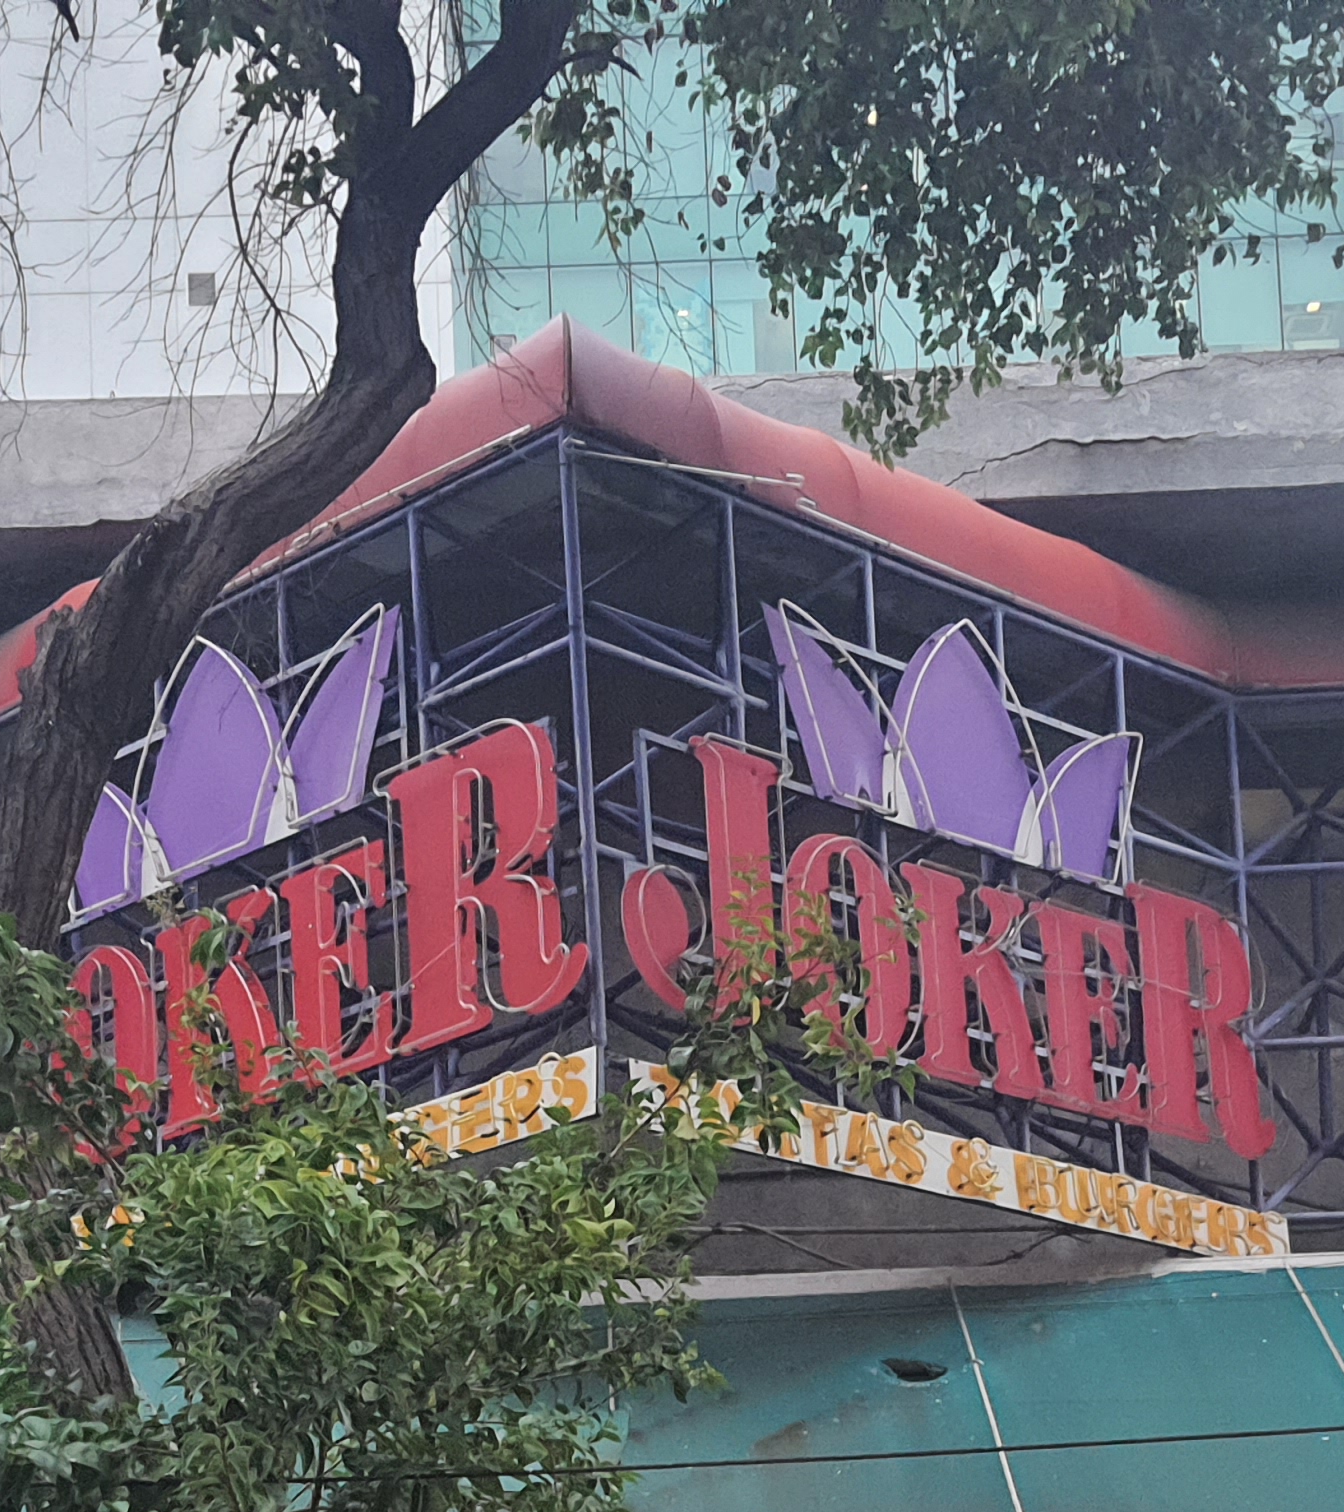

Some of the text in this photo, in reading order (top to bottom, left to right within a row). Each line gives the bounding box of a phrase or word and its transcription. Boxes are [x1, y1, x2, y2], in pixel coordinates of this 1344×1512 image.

[46, 718, 588, 1168] OKER
[622, 733, 1276, 1160] JOKER
[947, 1138, 1003, 1200] &
[1013, 1152, 1292, 1257] BURGERS
